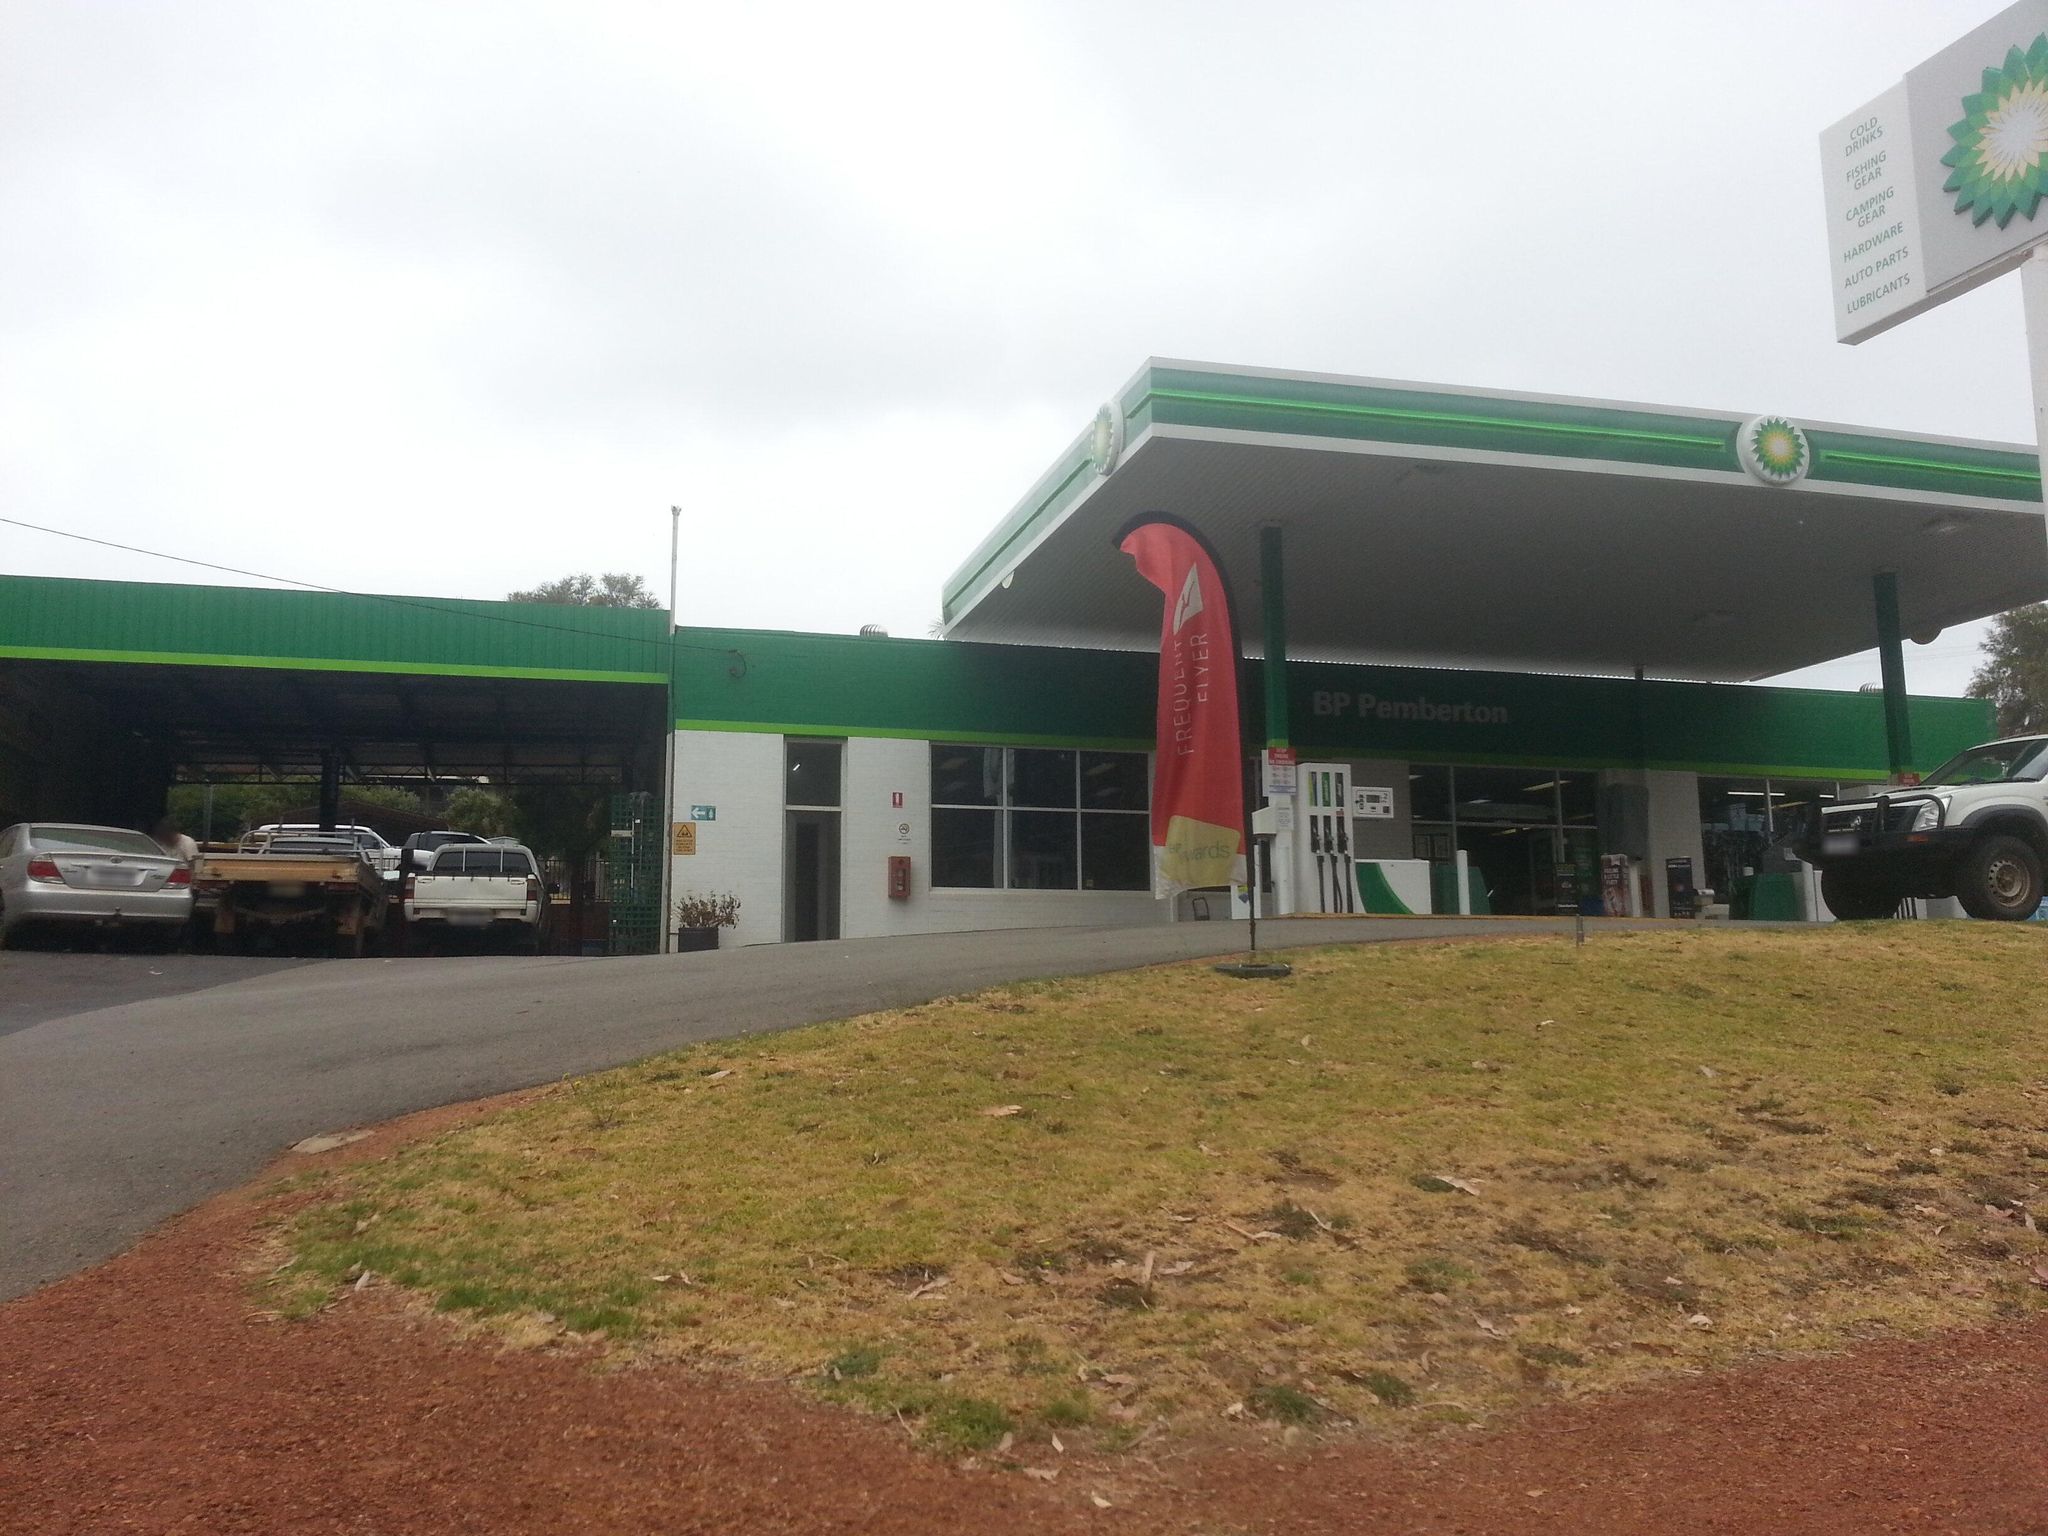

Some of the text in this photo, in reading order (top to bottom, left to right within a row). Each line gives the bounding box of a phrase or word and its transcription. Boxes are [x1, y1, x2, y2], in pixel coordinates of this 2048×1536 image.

[1844, 126, 1884, 157] DRINKS
[1850, 116, 1878, 141] COLD
[1846, 150, 1887, 182] FISHING
[1853, 166, 1882, 191] GEAR
[1846, 186, 1895, 222] CAMPING
[1857, 204, 1886, 228] GEAR
[1843, 221, 1904, 263] HARDWARE
[1844, 246, 1909, 289] AUTO PARTS
[1847, 272, 1911, 314] LUBRICANTS
[1313, 691, 1508, 723] BP Pemberton
